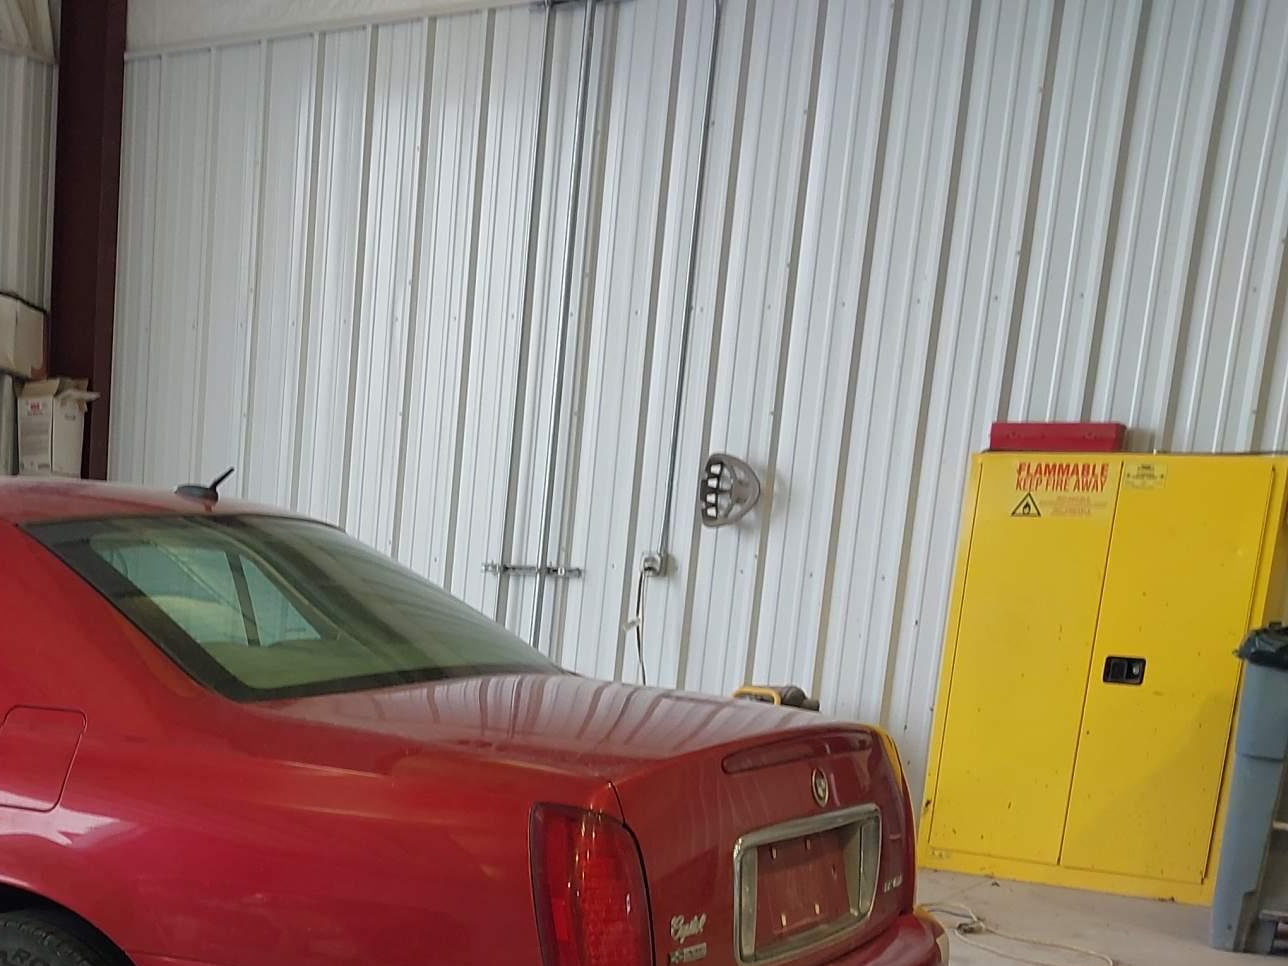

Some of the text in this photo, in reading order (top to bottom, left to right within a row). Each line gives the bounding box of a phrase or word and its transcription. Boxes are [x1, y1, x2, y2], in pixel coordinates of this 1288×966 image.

[1016, 463, 1109, 478] FLAMMABLE
[1016, 476, 1107, 492] KEEP FIRE AWAY
